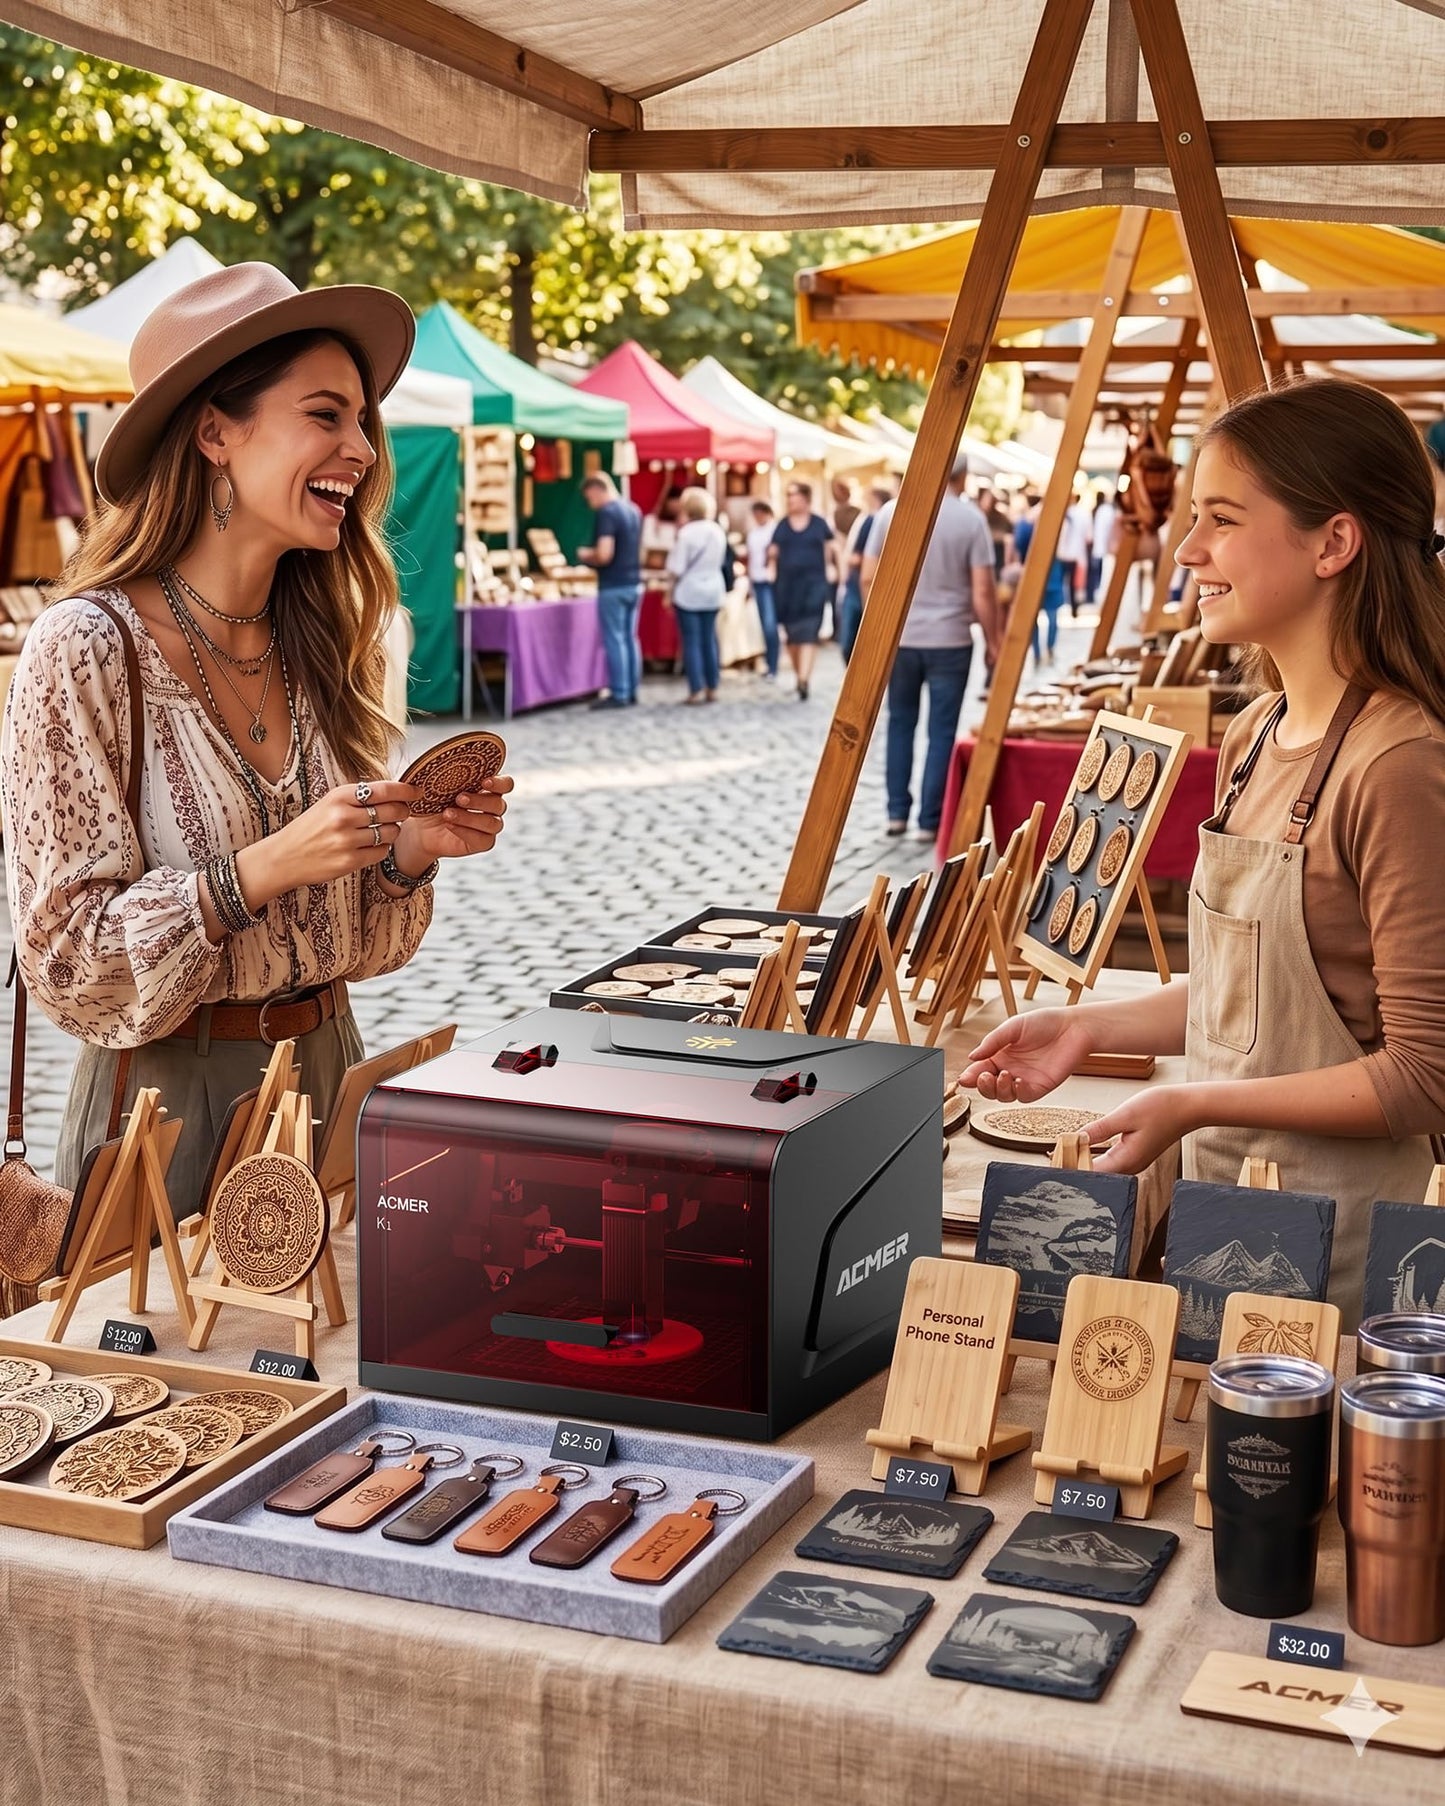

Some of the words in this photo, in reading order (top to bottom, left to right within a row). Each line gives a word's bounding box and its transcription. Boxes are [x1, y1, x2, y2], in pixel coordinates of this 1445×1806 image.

[377, 1195, 430, 1214] ACMER
[376, 1216, 392, 1231] K1
[835, 1232, 910, 1297] ACMER
[922, 1308, 985, 1329] Personal
[114, 1342, 134, 1353] EACH
[905, 1325, 951, 1344] Phone
[953, 1332, 996, 1350] Stand
[257, 1358, 297, 1378] $12.00
[559, 1431, 603, 1452] $2.50
[1060, 1488, 1107, 1510] $7.50
[1278, 1635, 1331, 1660] $32.00
